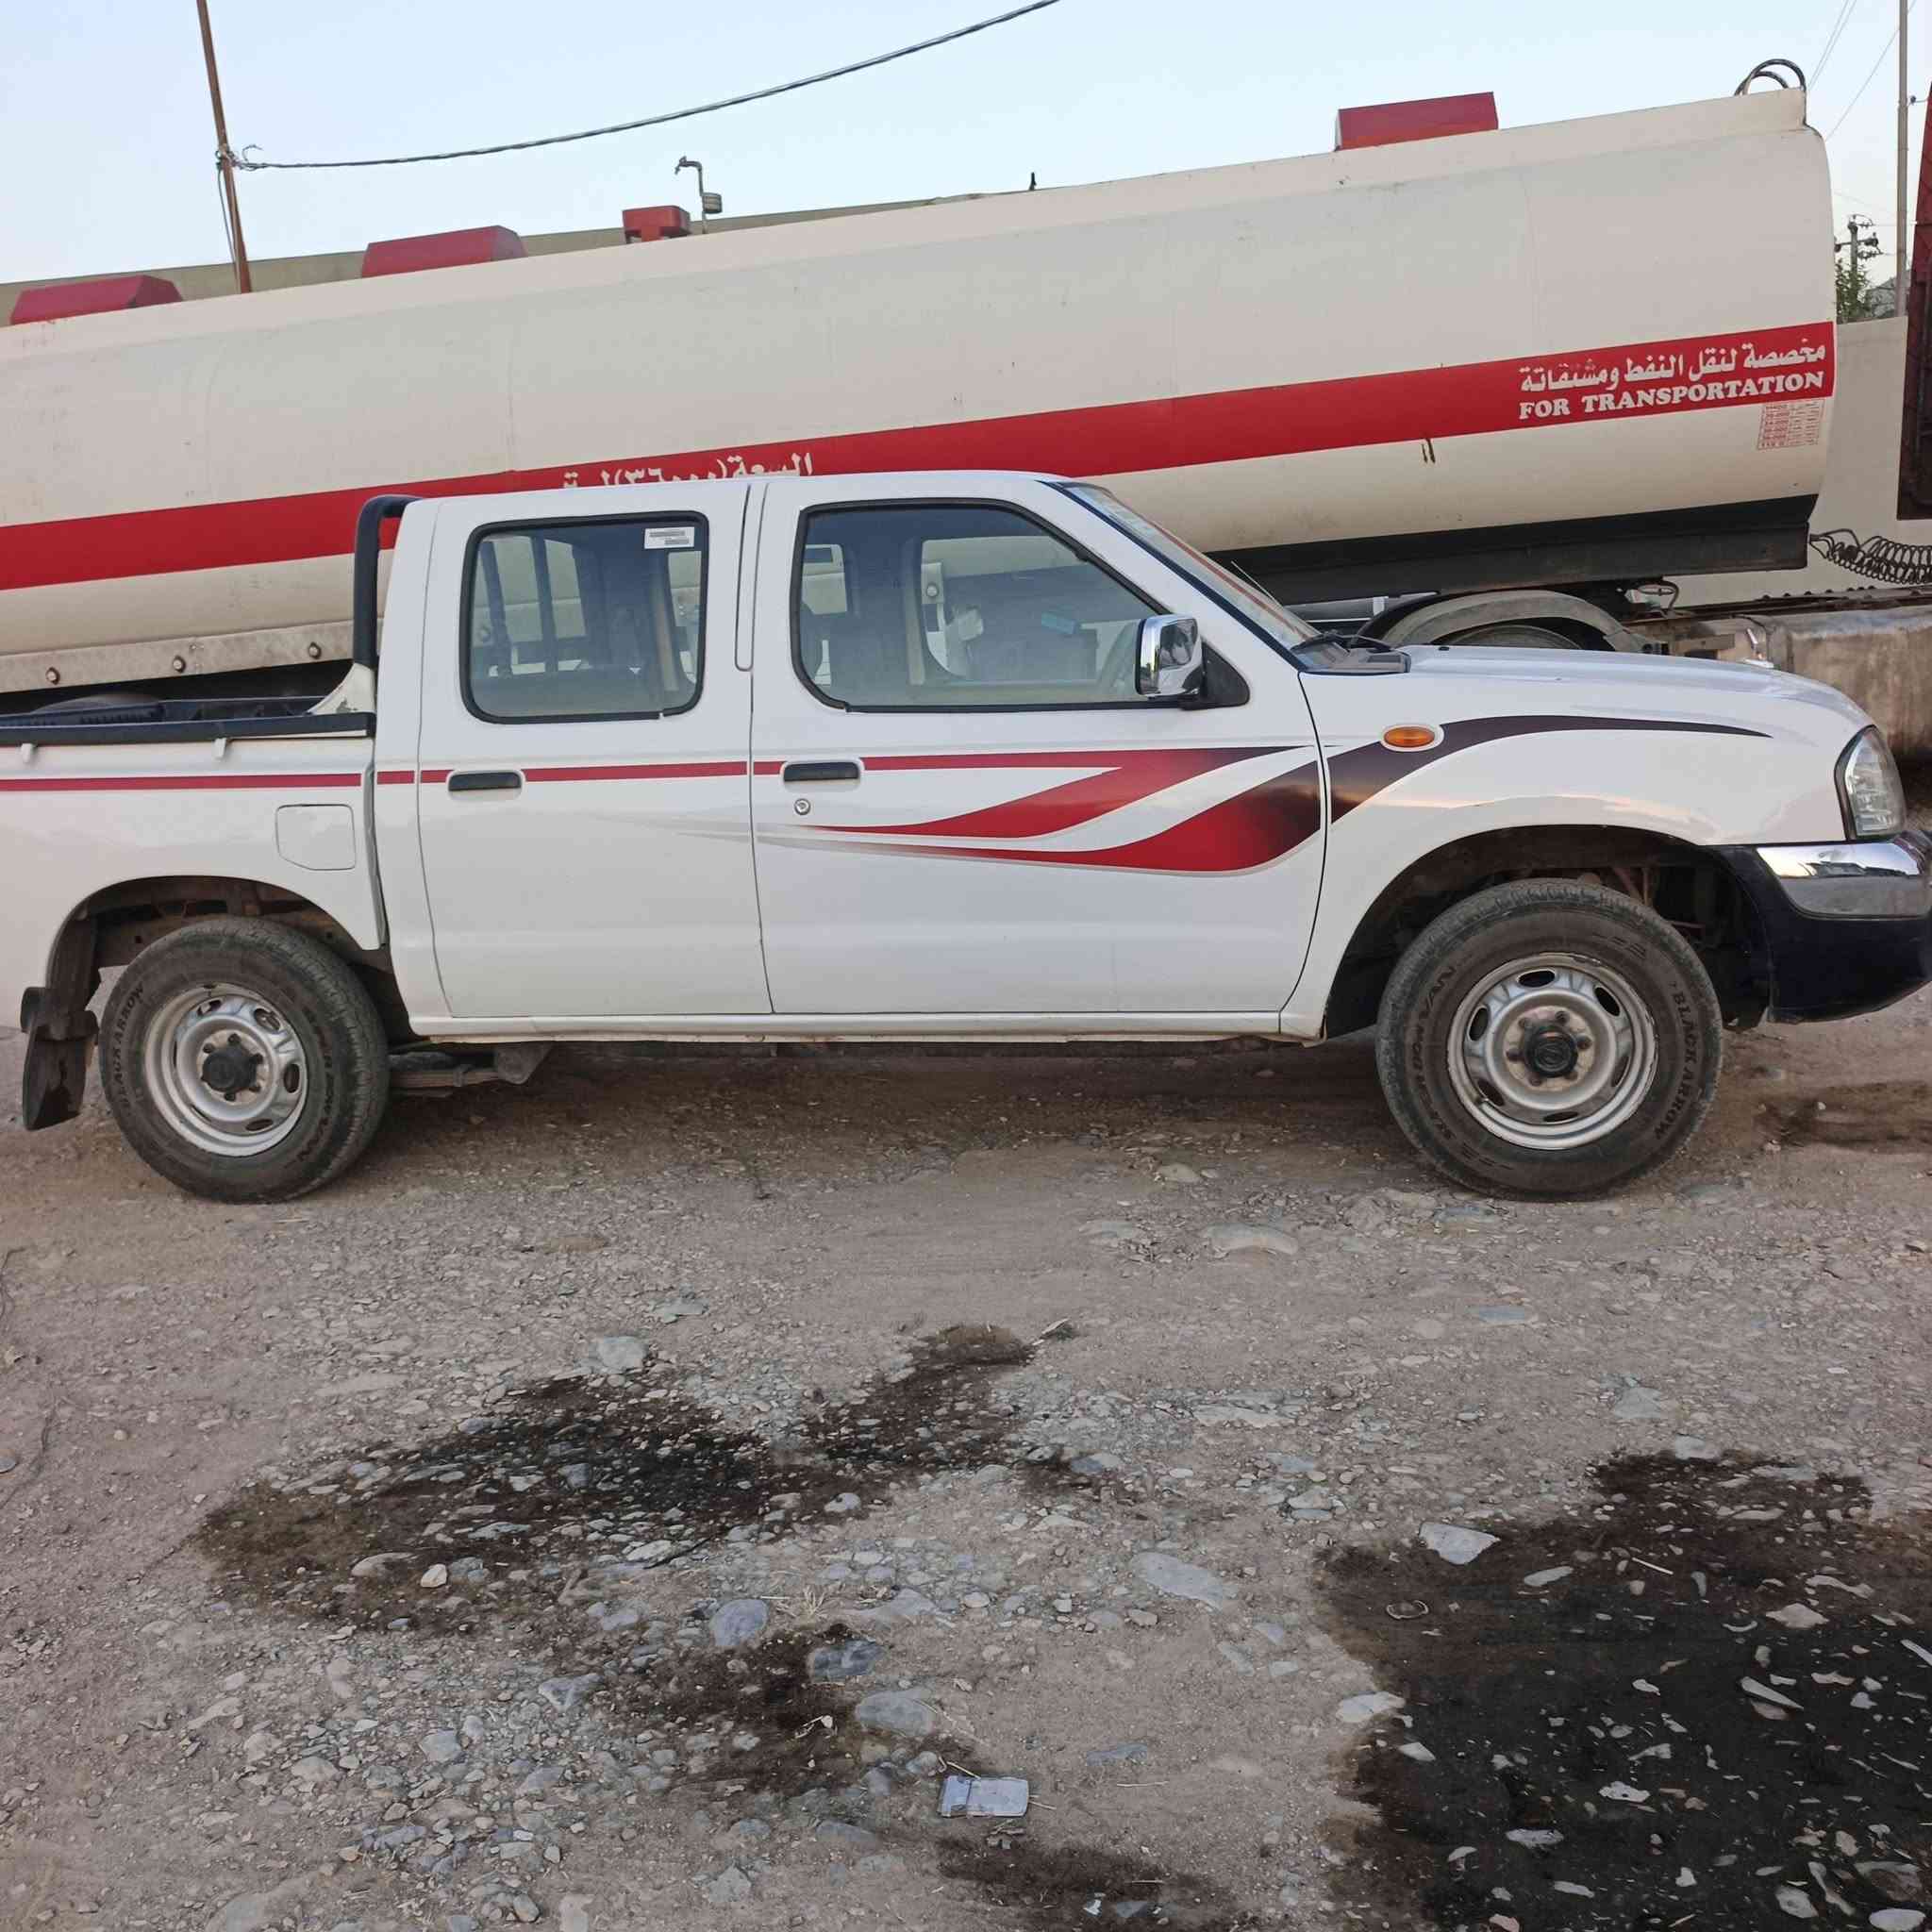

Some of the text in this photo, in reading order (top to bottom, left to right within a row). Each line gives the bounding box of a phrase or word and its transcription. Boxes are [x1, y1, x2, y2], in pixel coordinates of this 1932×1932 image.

[1624, 353, 1684, 382] النفط
[1689, 347, 1738, 382] لنقل
[1742, 338, 1826, 369] مخصصة
[1519, 371, 1824, 420] FOR TRANSPORTATION
